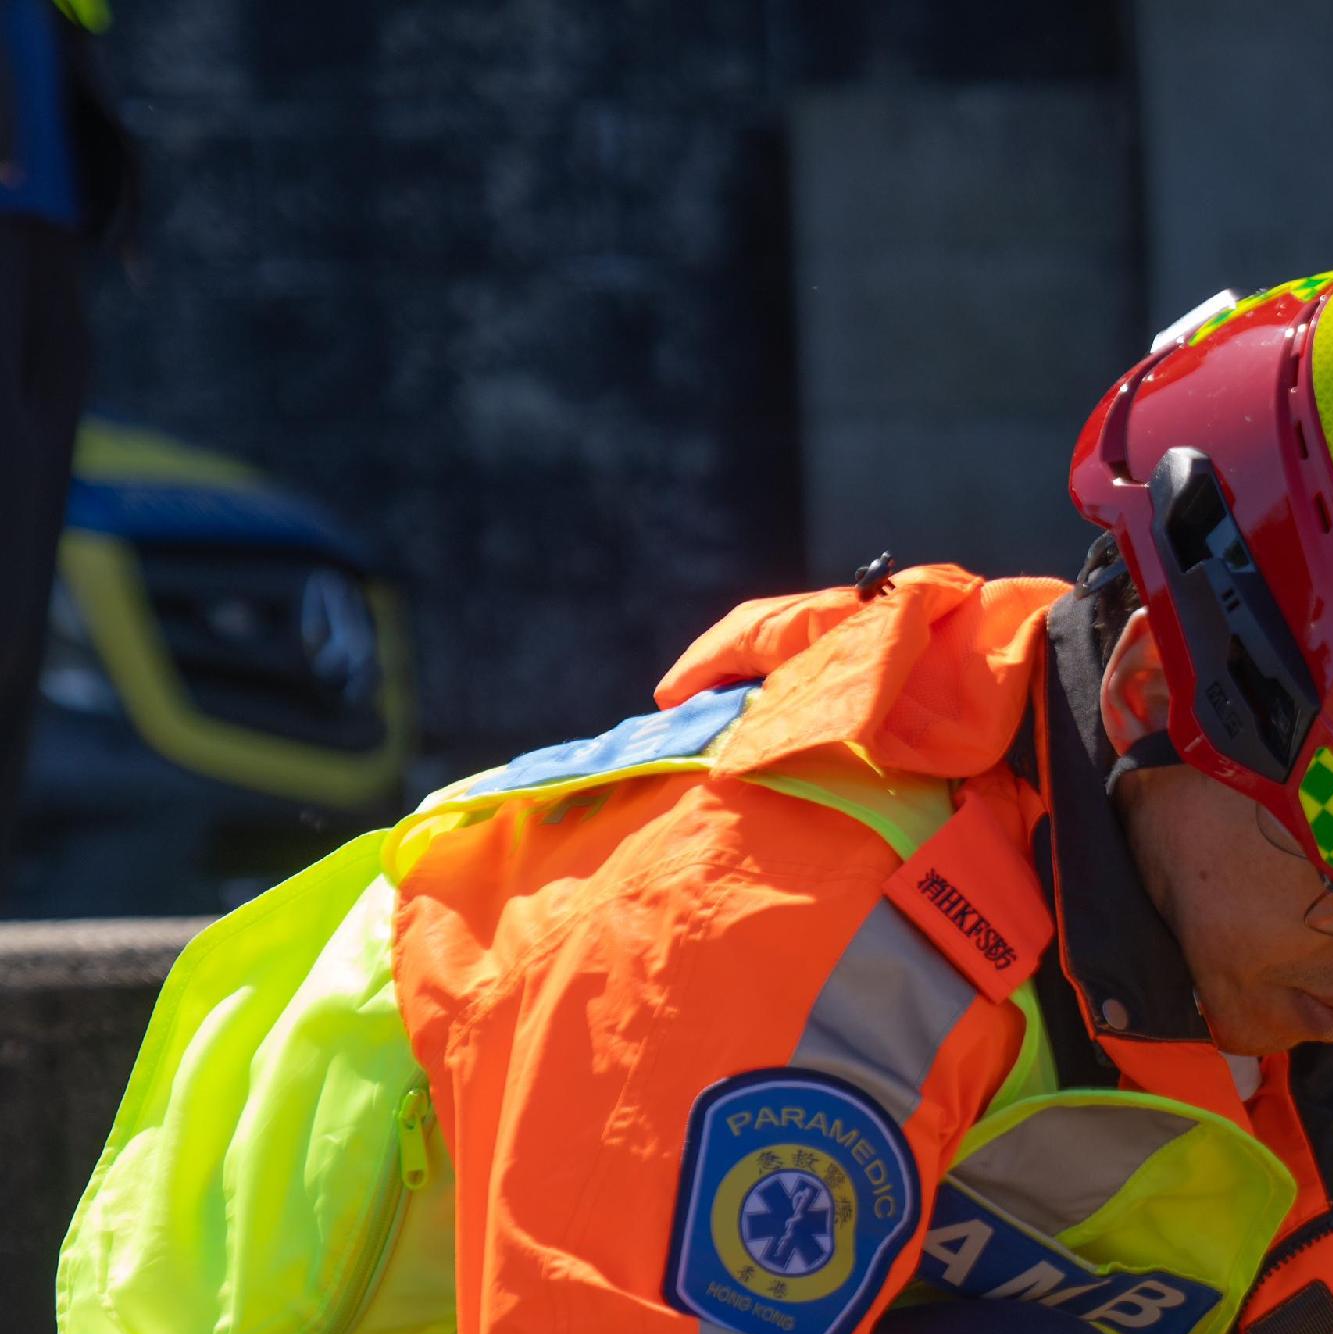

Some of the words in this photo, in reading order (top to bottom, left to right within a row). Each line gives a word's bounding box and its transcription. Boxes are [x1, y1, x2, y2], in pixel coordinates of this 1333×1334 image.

[726, 1107, 896, 1218] PARAMEDIC
[708, 1282, 751, 1312] HONG
[751, 1303, 795, 1331] KONG
